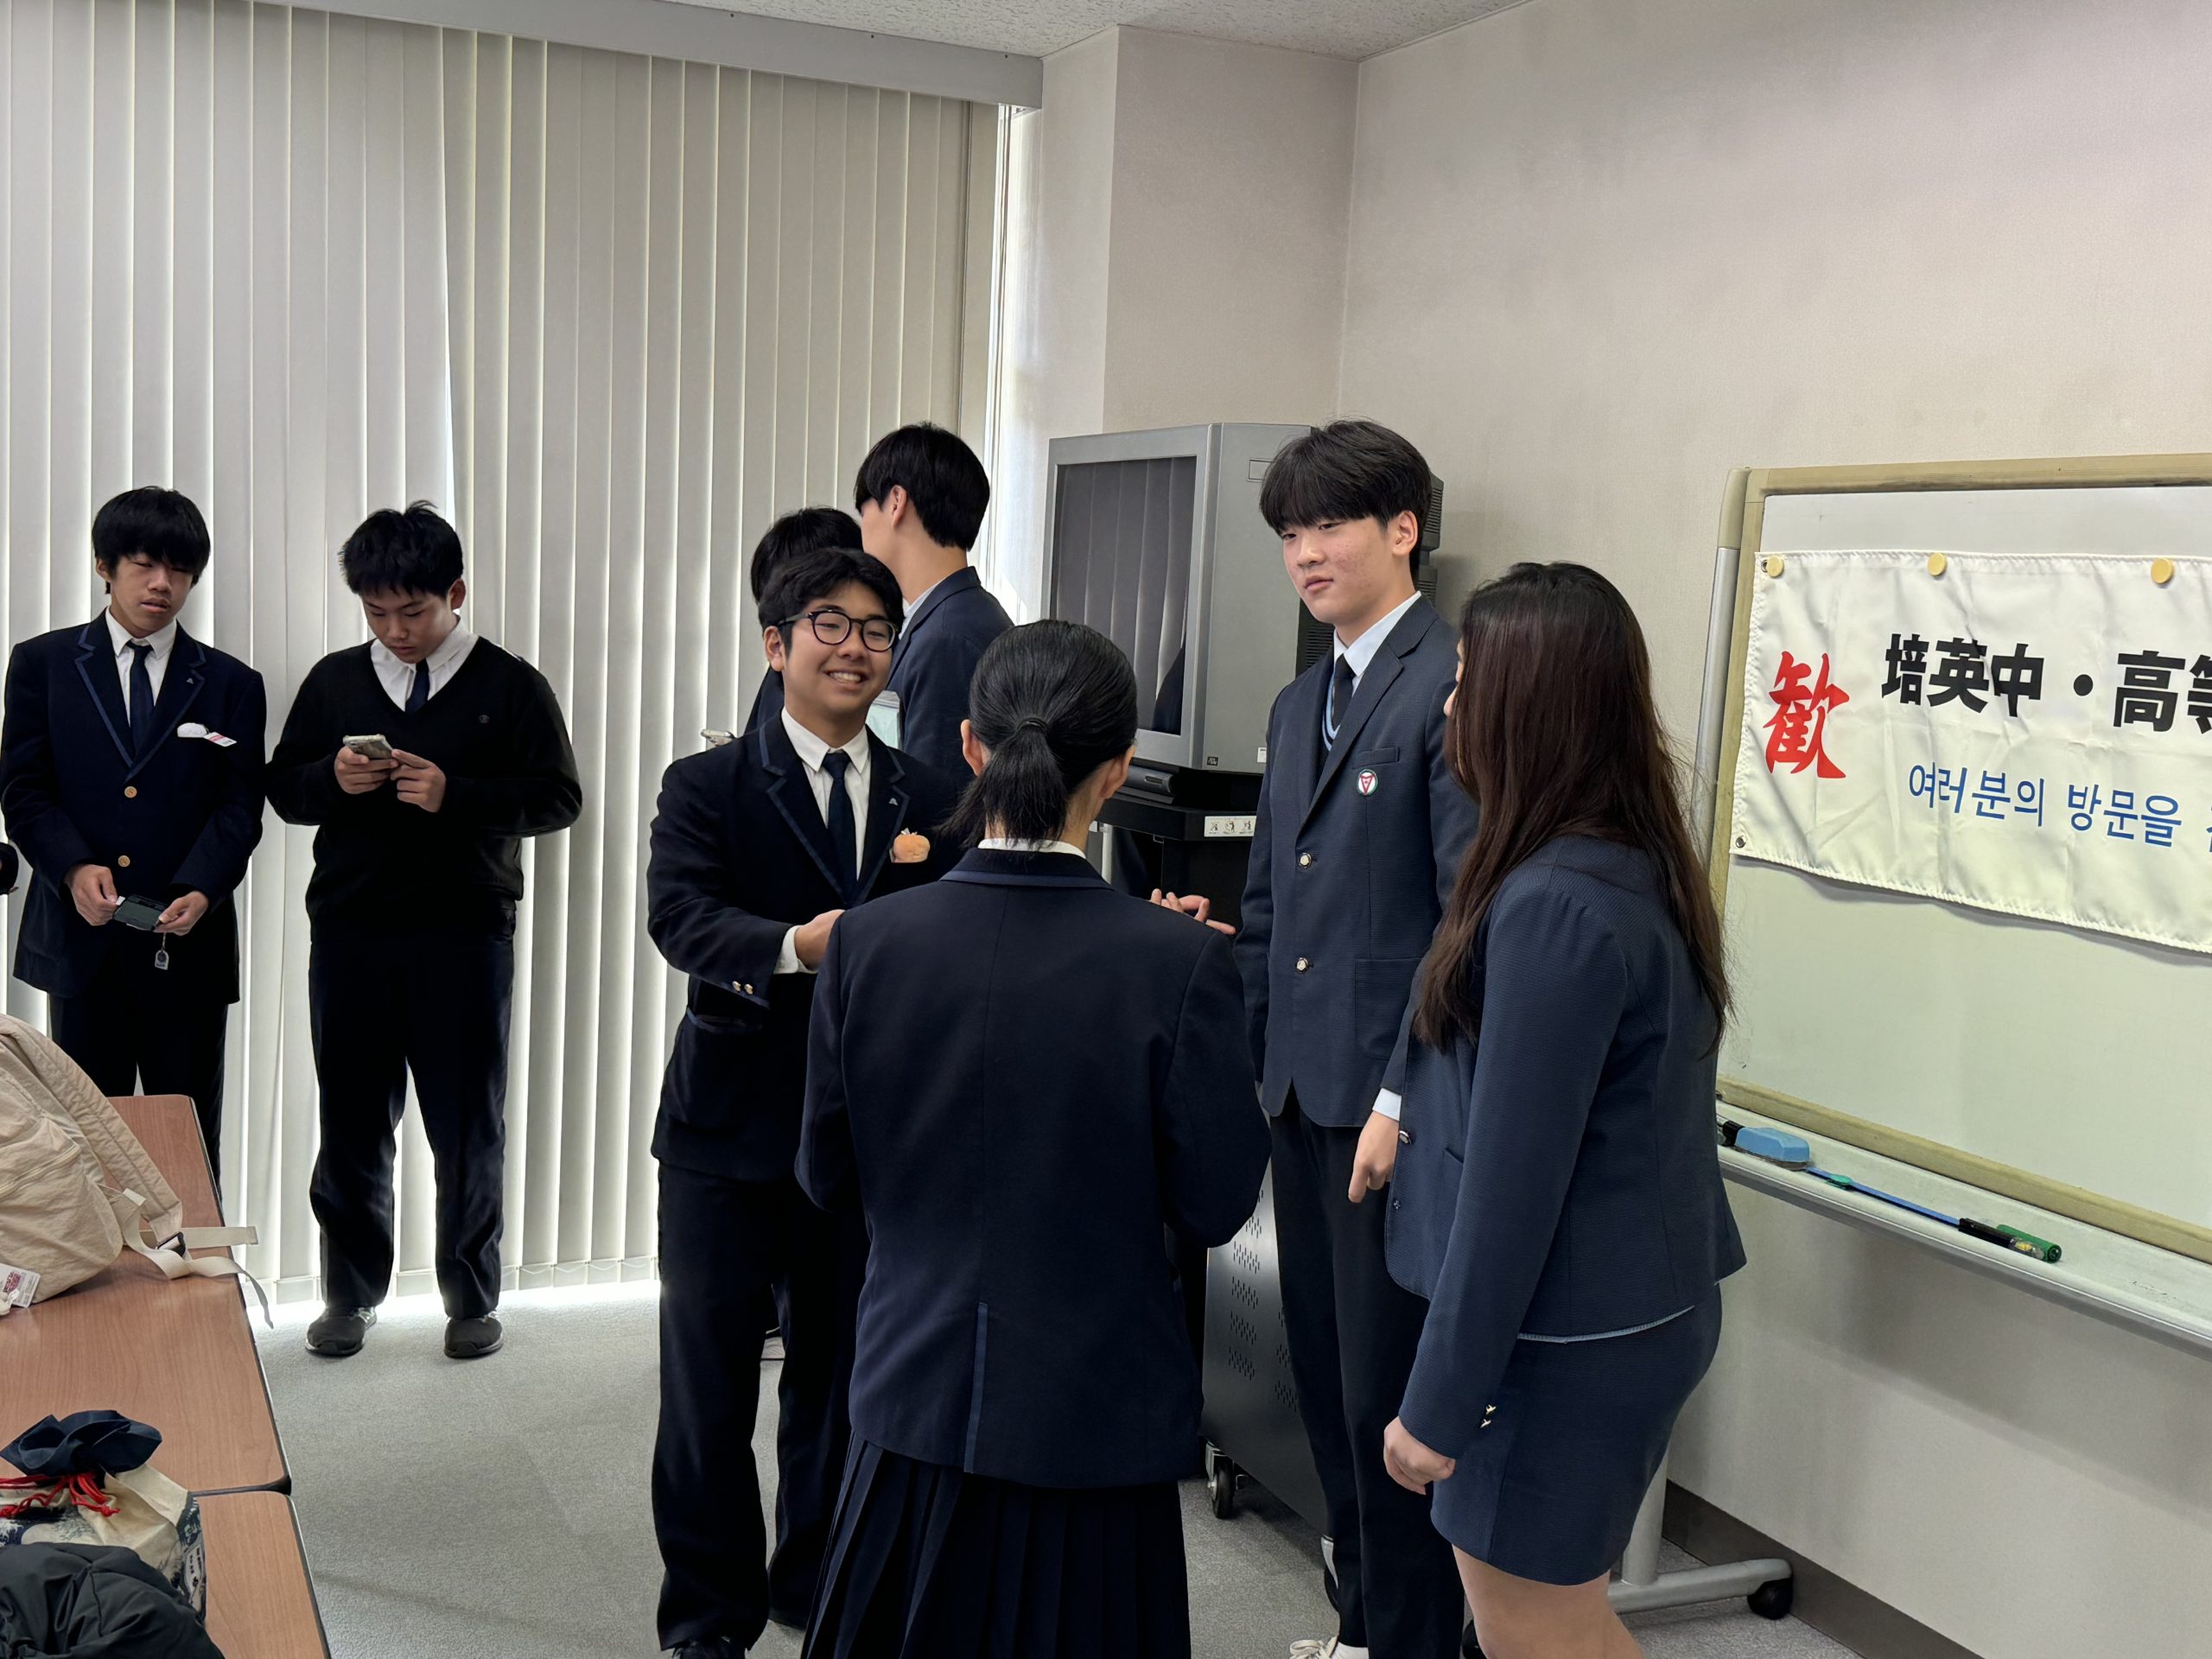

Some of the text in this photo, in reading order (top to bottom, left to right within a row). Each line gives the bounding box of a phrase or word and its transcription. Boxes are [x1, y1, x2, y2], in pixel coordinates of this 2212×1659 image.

[1763, 651, 1850, 779] 歓
[1909, 762, 2045, 828] 여러분의
[2068, 784, 2182, 848] 방문을
